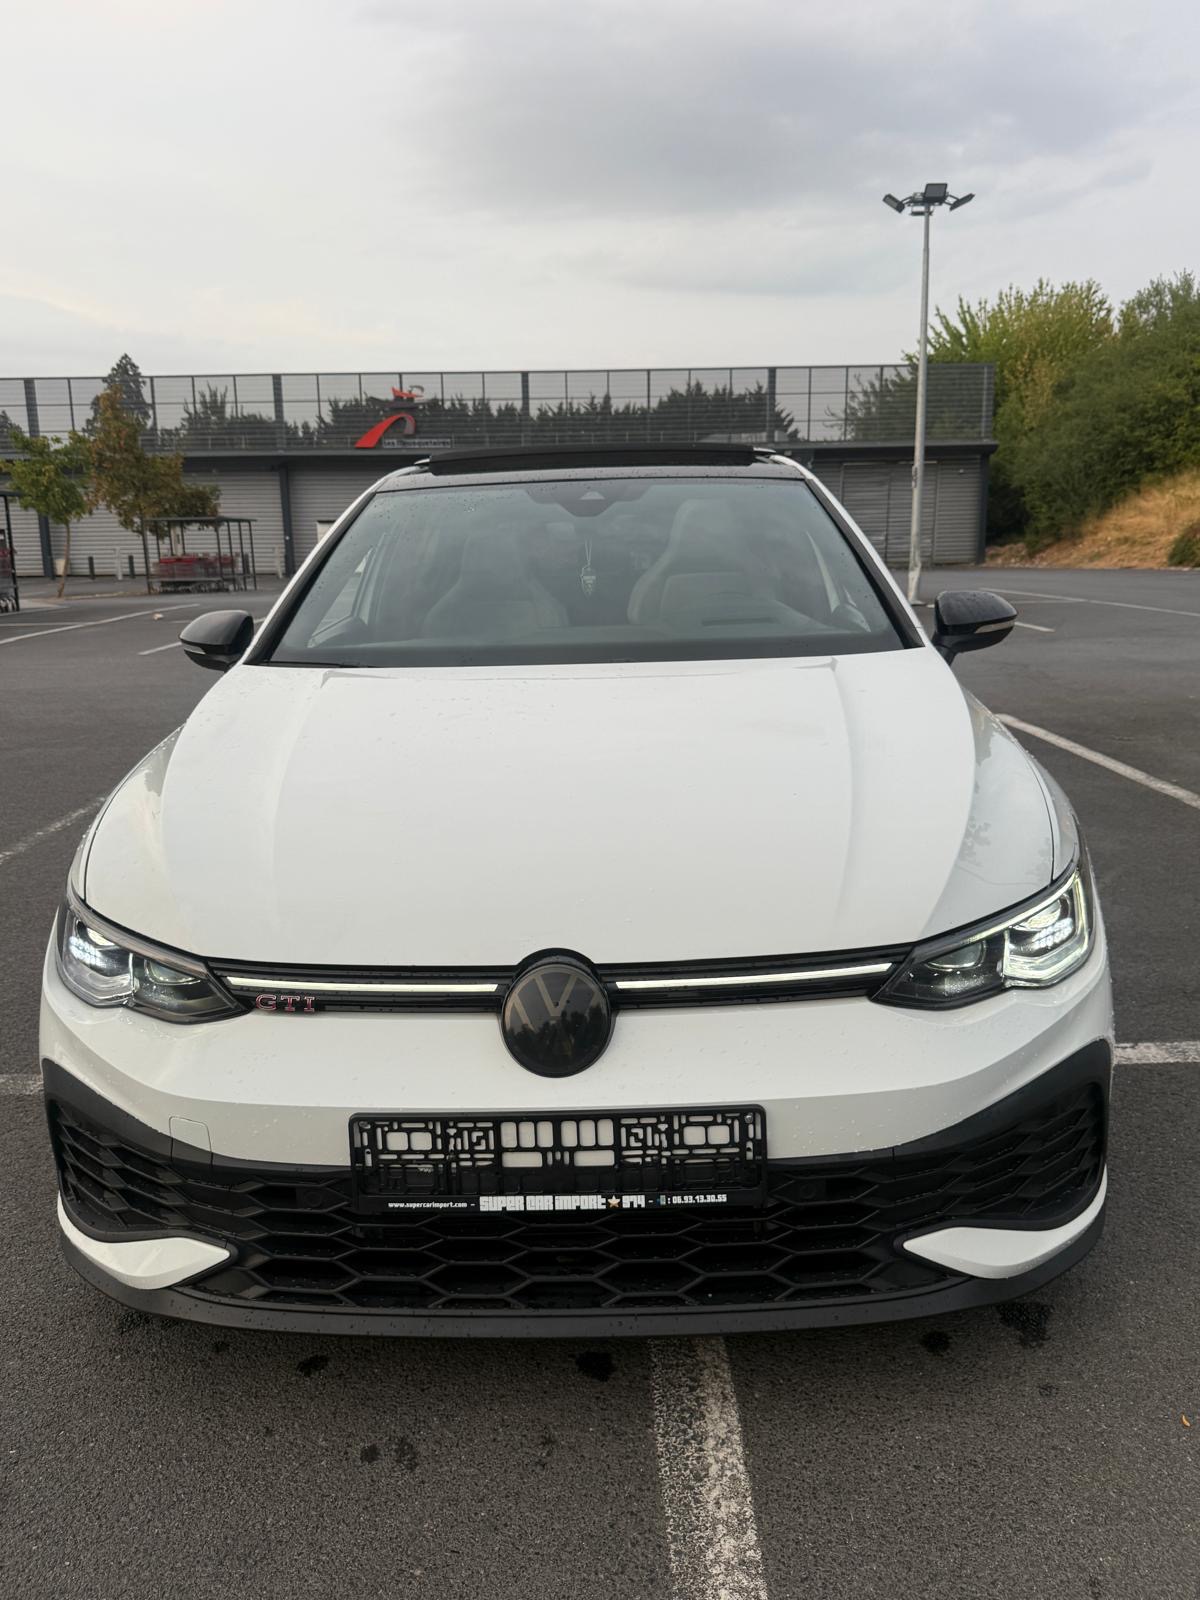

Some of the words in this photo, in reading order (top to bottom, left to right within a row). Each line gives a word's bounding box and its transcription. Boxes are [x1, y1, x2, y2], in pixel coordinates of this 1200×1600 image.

[255, 993, 315, 1013] GTI
[387, 1201, 468, 1209] www.supercarimport.com
[526, 1195, 554, 1211] CAR
[622, 1194, 646, 1209] 974
